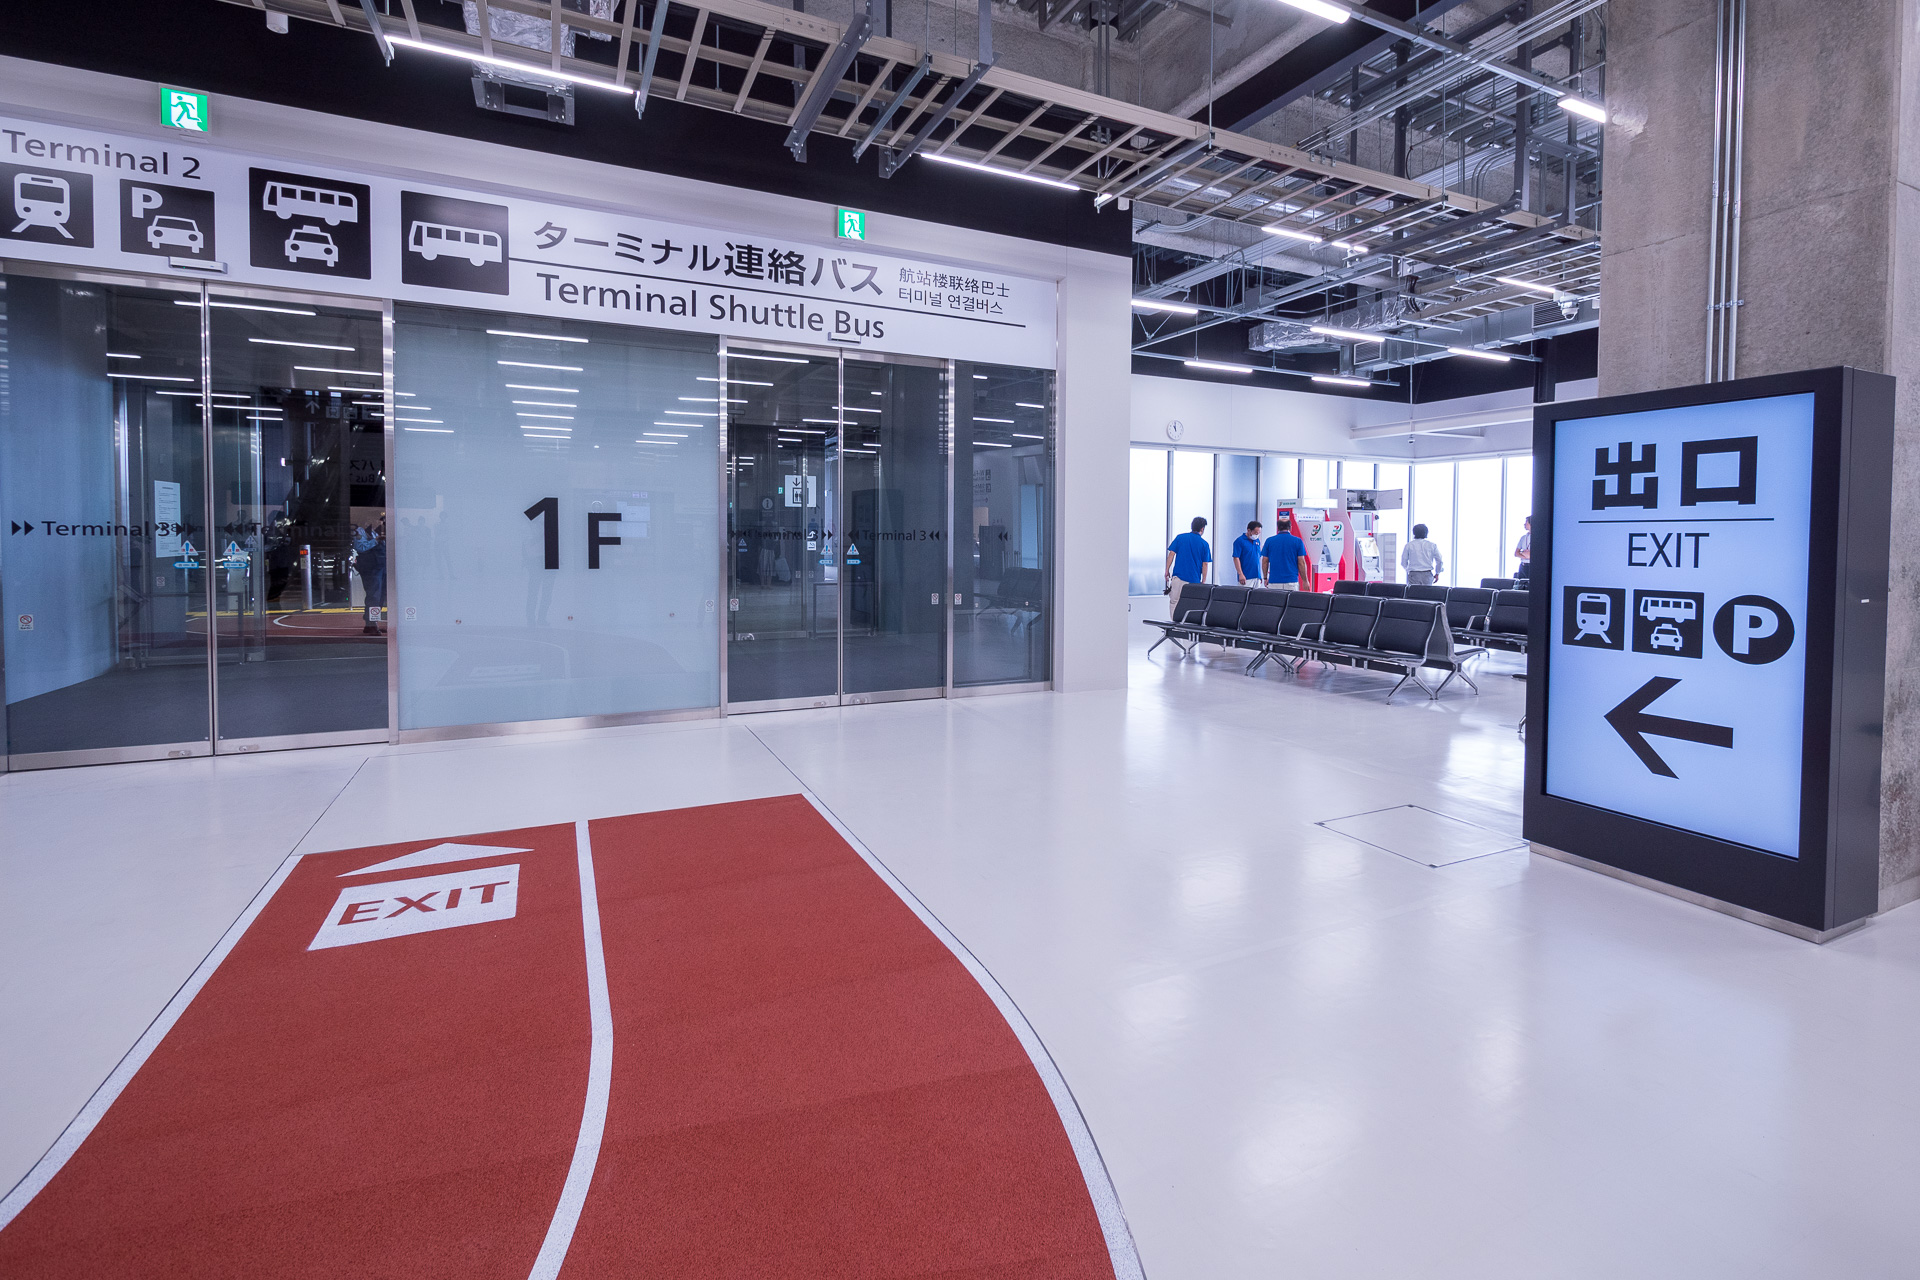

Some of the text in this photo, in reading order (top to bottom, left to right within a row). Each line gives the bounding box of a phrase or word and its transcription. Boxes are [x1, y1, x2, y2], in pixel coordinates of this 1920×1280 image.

[2, 129, 201, 180] Terminal 2
[534, 221, 883, 296] ターミナル連絡バス
[898, 287, 1003, 315] 터미널 연결버스
[899, 267, 1010, 298] 航站楼联络巴士
[536, 272, 884, 338] Terminal Shuttle Bus
[1592, 436, 1758, 511] 出口
[41, 521, 149, 537] Terminal
[158, 522, 170, 537] 3
[863, 529, 927, 541] Terminal 3
[1628, 533, 1710, 568] EXIT
[337, 881, 511, 926] EXIT
